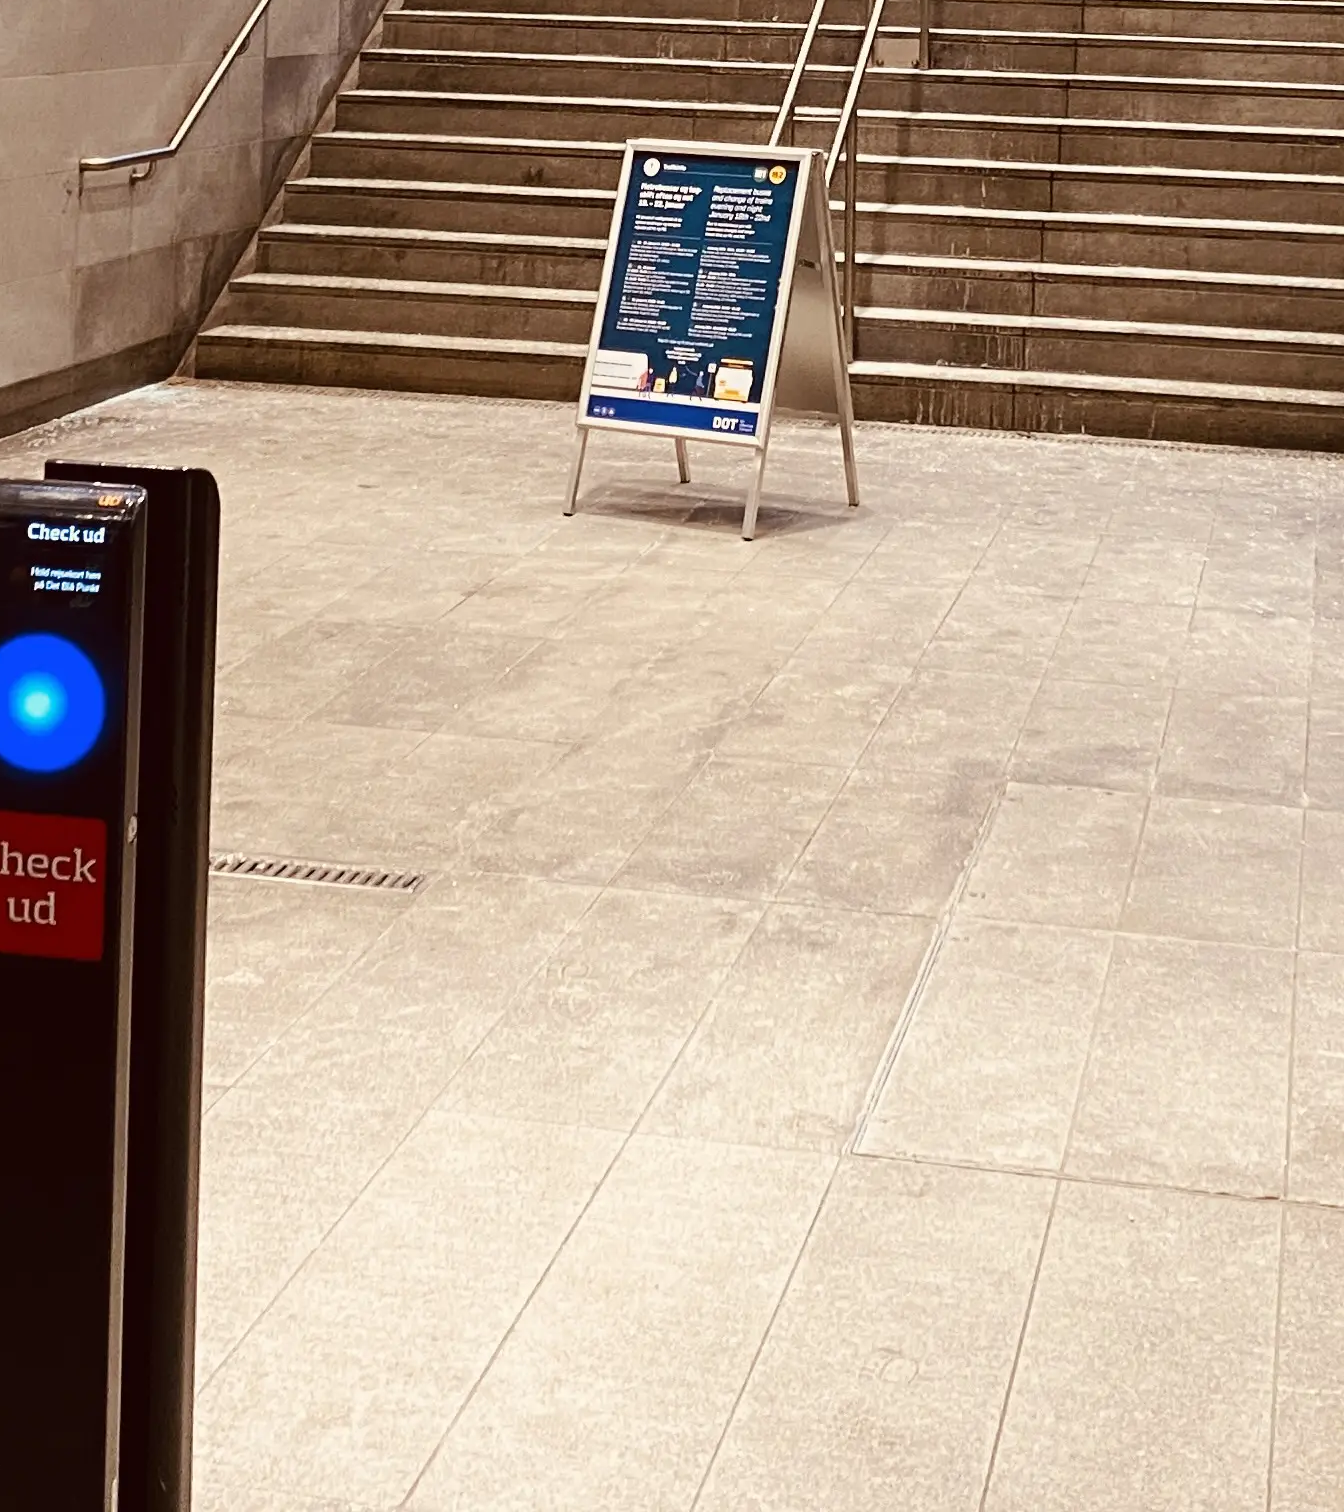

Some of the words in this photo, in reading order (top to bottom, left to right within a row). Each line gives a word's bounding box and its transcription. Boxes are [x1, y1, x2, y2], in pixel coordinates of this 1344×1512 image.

[712, 416, 739, 431] DOT
[27, 522, 81, 542] Check
[82, 527, 105, 544] ud
[7, 892, 58, 925] ud
